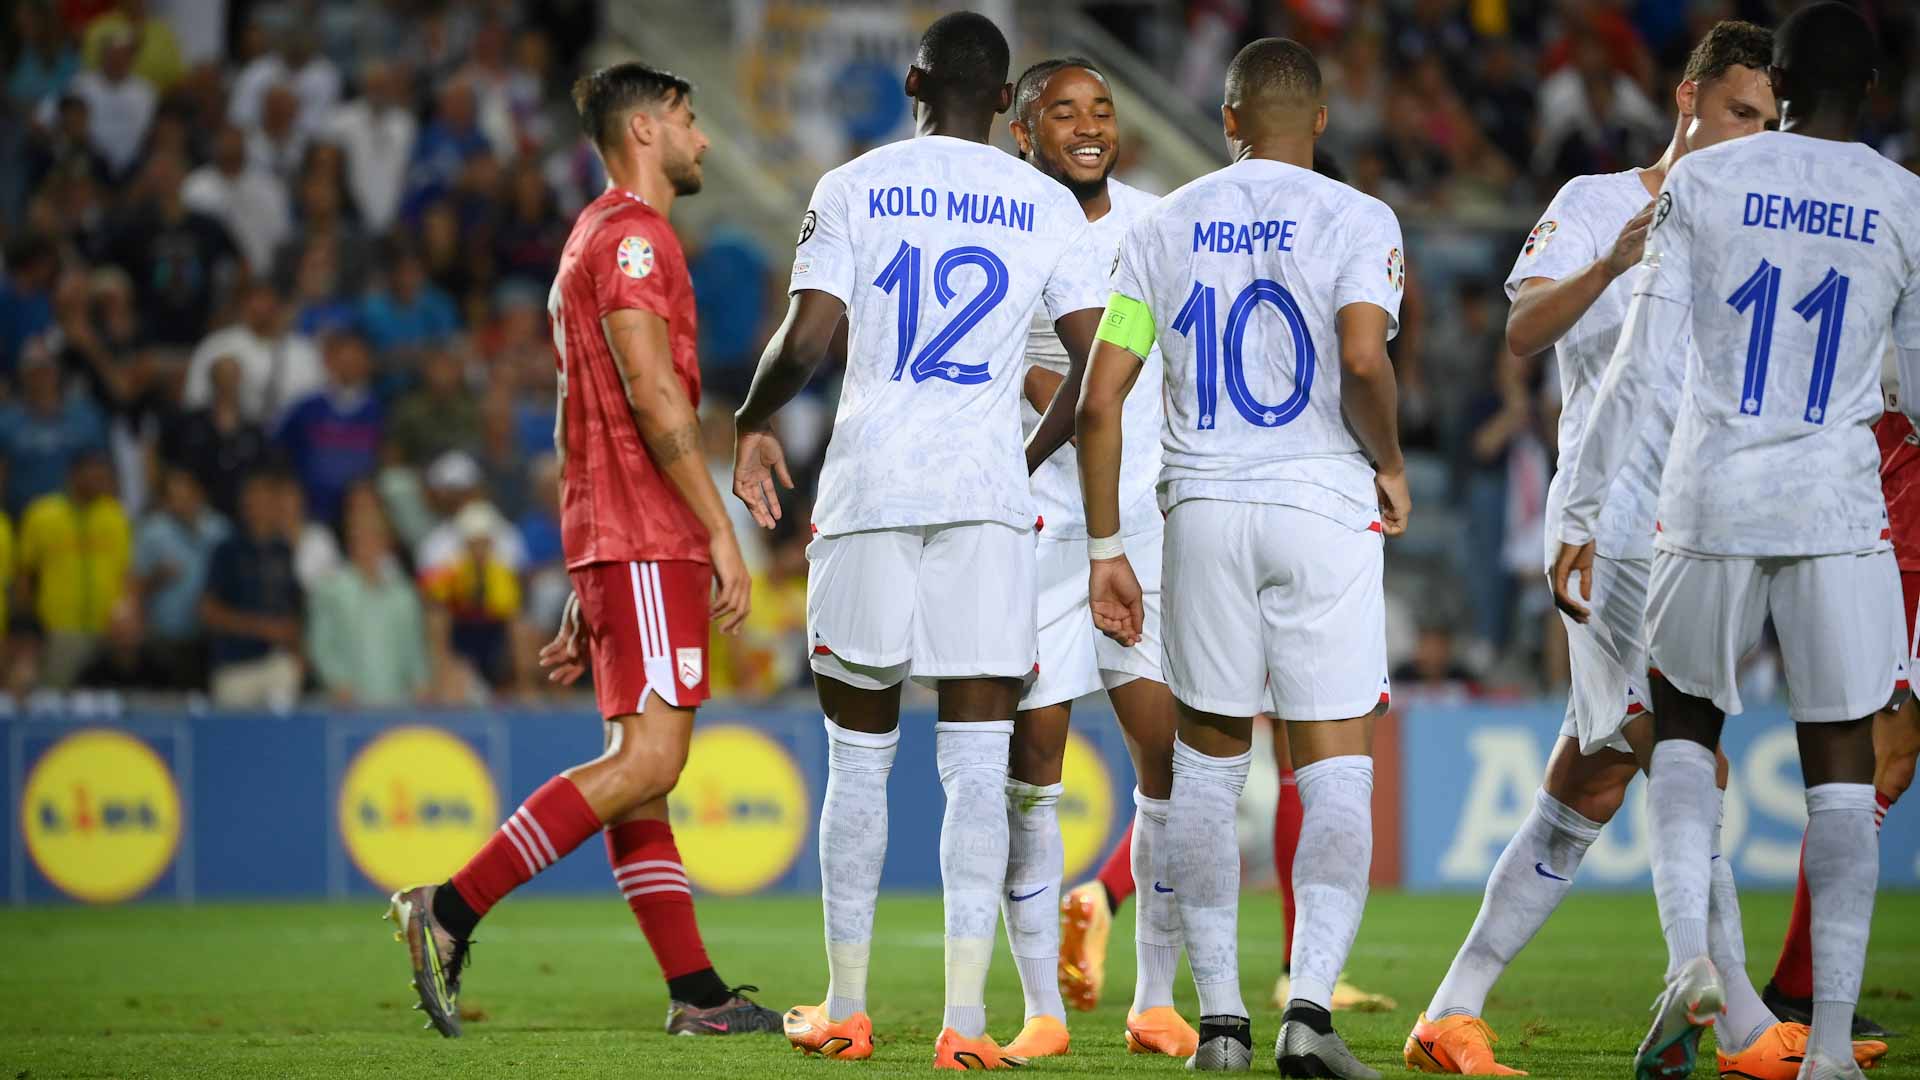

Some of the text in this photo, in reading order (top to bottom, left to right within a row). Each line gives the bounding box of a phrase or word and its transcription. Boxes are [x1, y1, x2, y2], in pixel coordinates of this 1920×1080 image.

[869, 186, 1035, 232] KOLO MUANI
[1193, 220, 1298, 257] MBAPPE
[1743, 193, 1880, 245] DEMBELE
[872, 239, 1010, 385] 12
[1172, 279, 1317, 431] 10
[1727, 258, 1851, 425] 11
